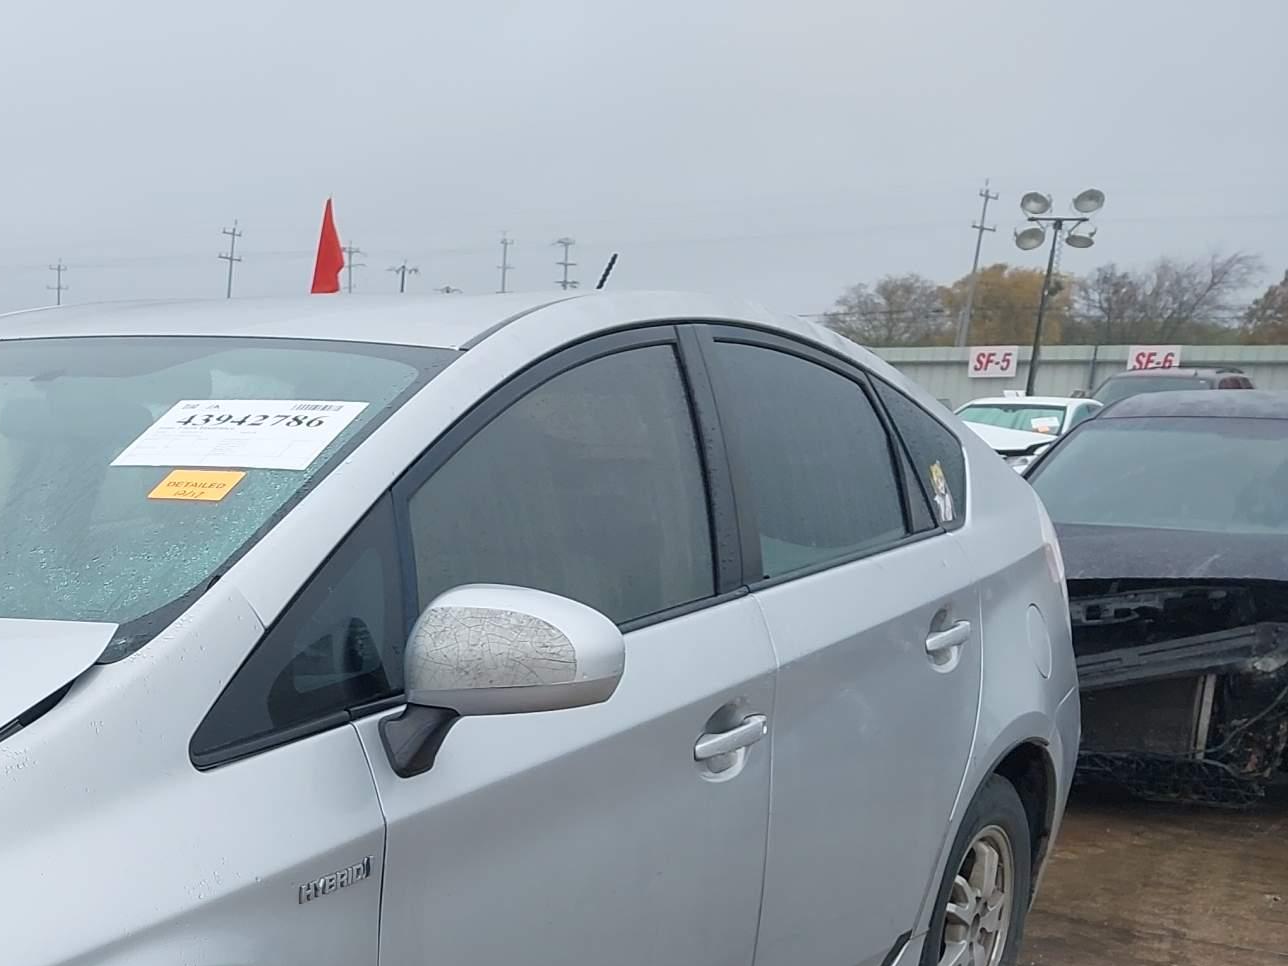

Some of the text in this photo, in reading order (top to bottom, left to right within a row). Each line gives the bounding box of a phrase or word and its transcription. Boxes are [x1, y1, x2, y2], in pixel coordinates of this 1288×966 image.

[974, 352, 1013, 372] SF-5
[1133, 352, 1176, 370] SF-6
[176, 413, 328, 428] 43942786
[166, 481, 227, 489] DETAILED
[298, 862, 365, 905] HYBRID
